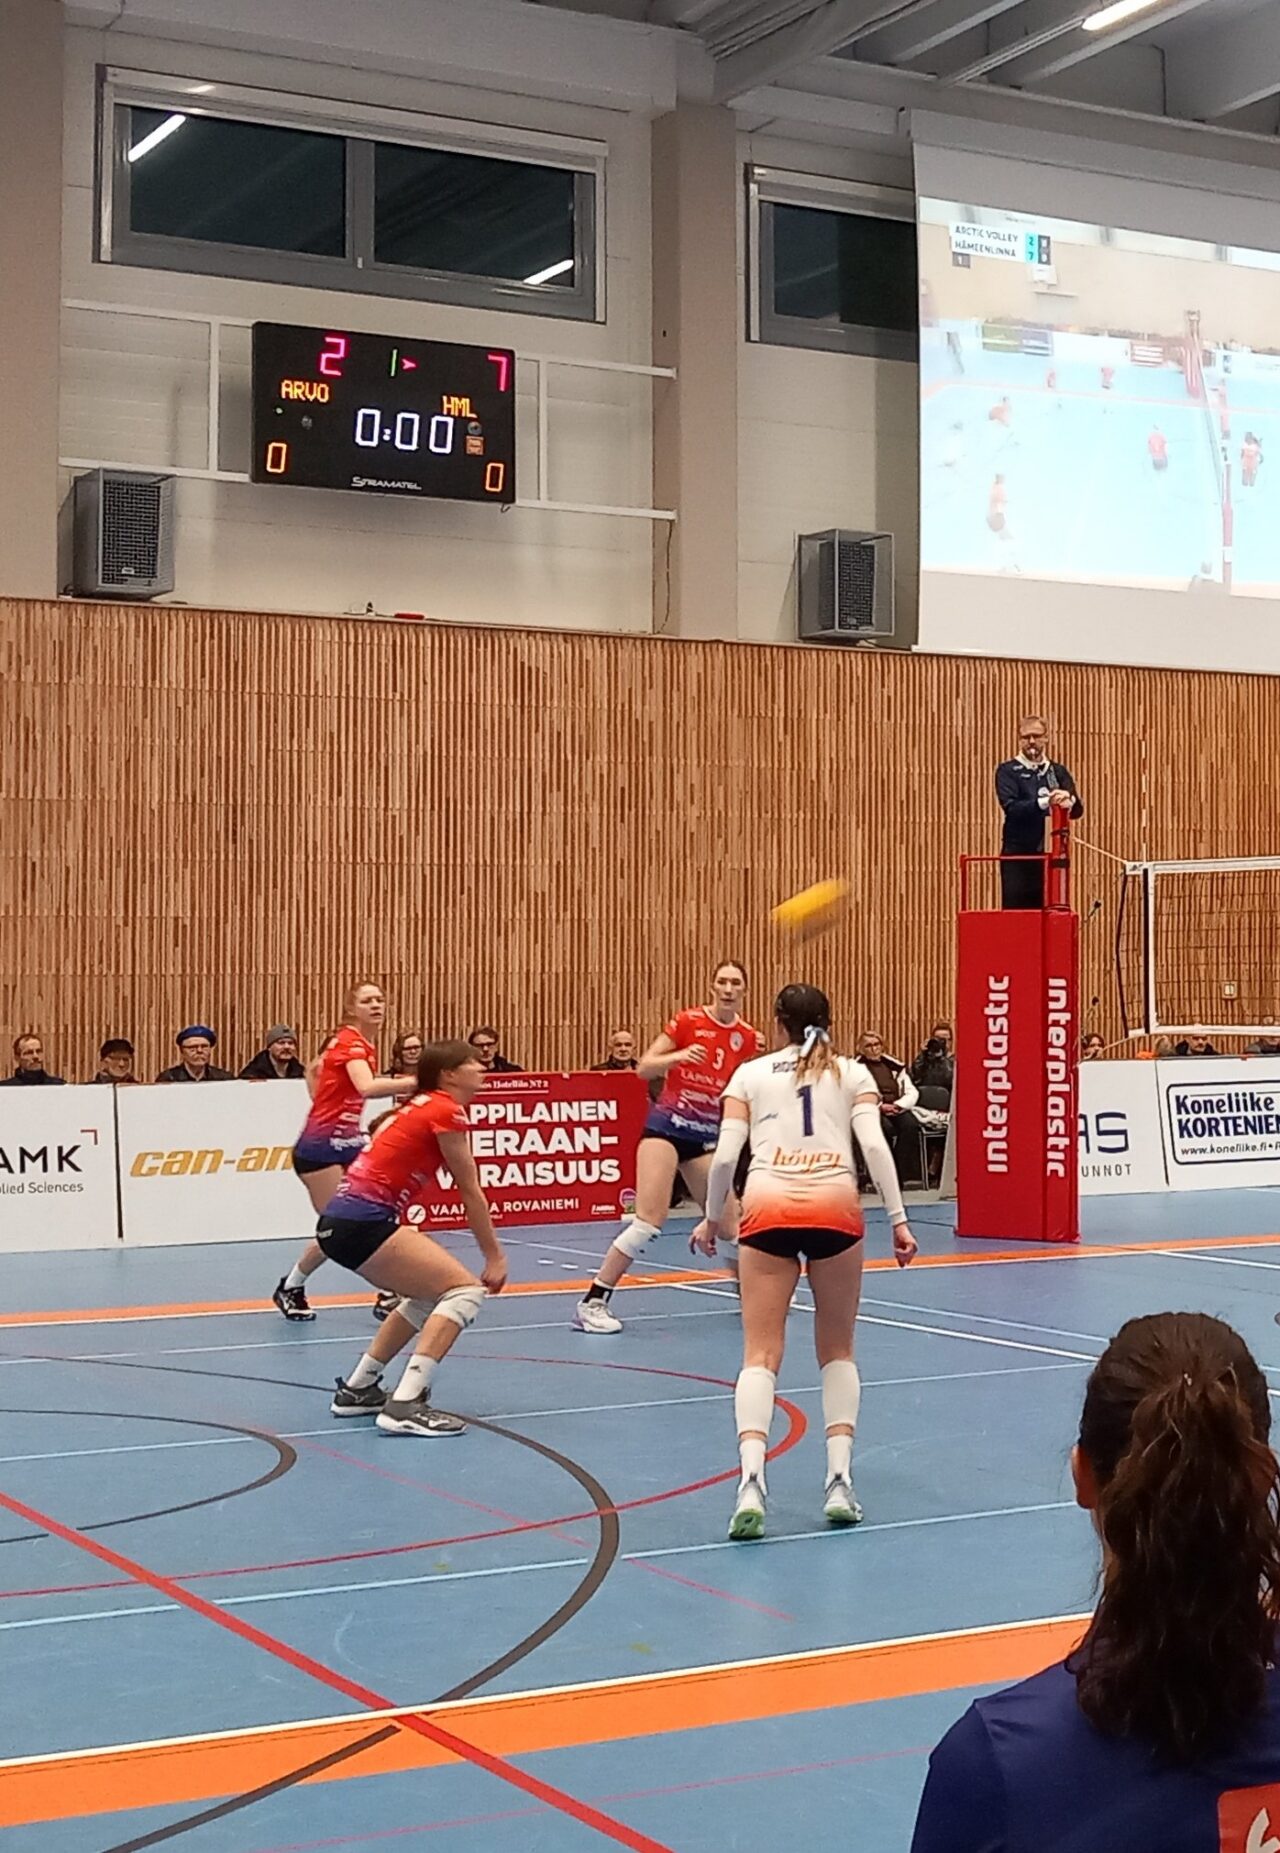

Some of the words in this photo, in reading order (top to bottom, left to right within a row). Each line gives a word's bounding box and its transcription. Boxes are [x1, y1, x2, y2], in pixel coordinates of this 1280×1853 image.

[320, 337, 346, 376] 2
[487, 354, 508, 392] 7
[281, 379, 329, 403] ARVO
[442, 395, 477, 418] HML
[266, 442, 287, 473] 0
[351, 476, 422, 490] STRAMATEL
[485, 462, 504, 492] 0
[712, 1047, 725, 1070] 3
[796, 1085, 814, 1137] 1
[1175, 1092, 1274, 1115] Koneliike
[435, 1159, 621, 1190] VRAISUUS
[1081, 1163, 1132, 1178] UNNOT
[28, 1182, 84, 1193] Sciences
[430, 1201, 499, 1216] VAAA
[503, 1197, 579, 1212] ROVANIEMI
